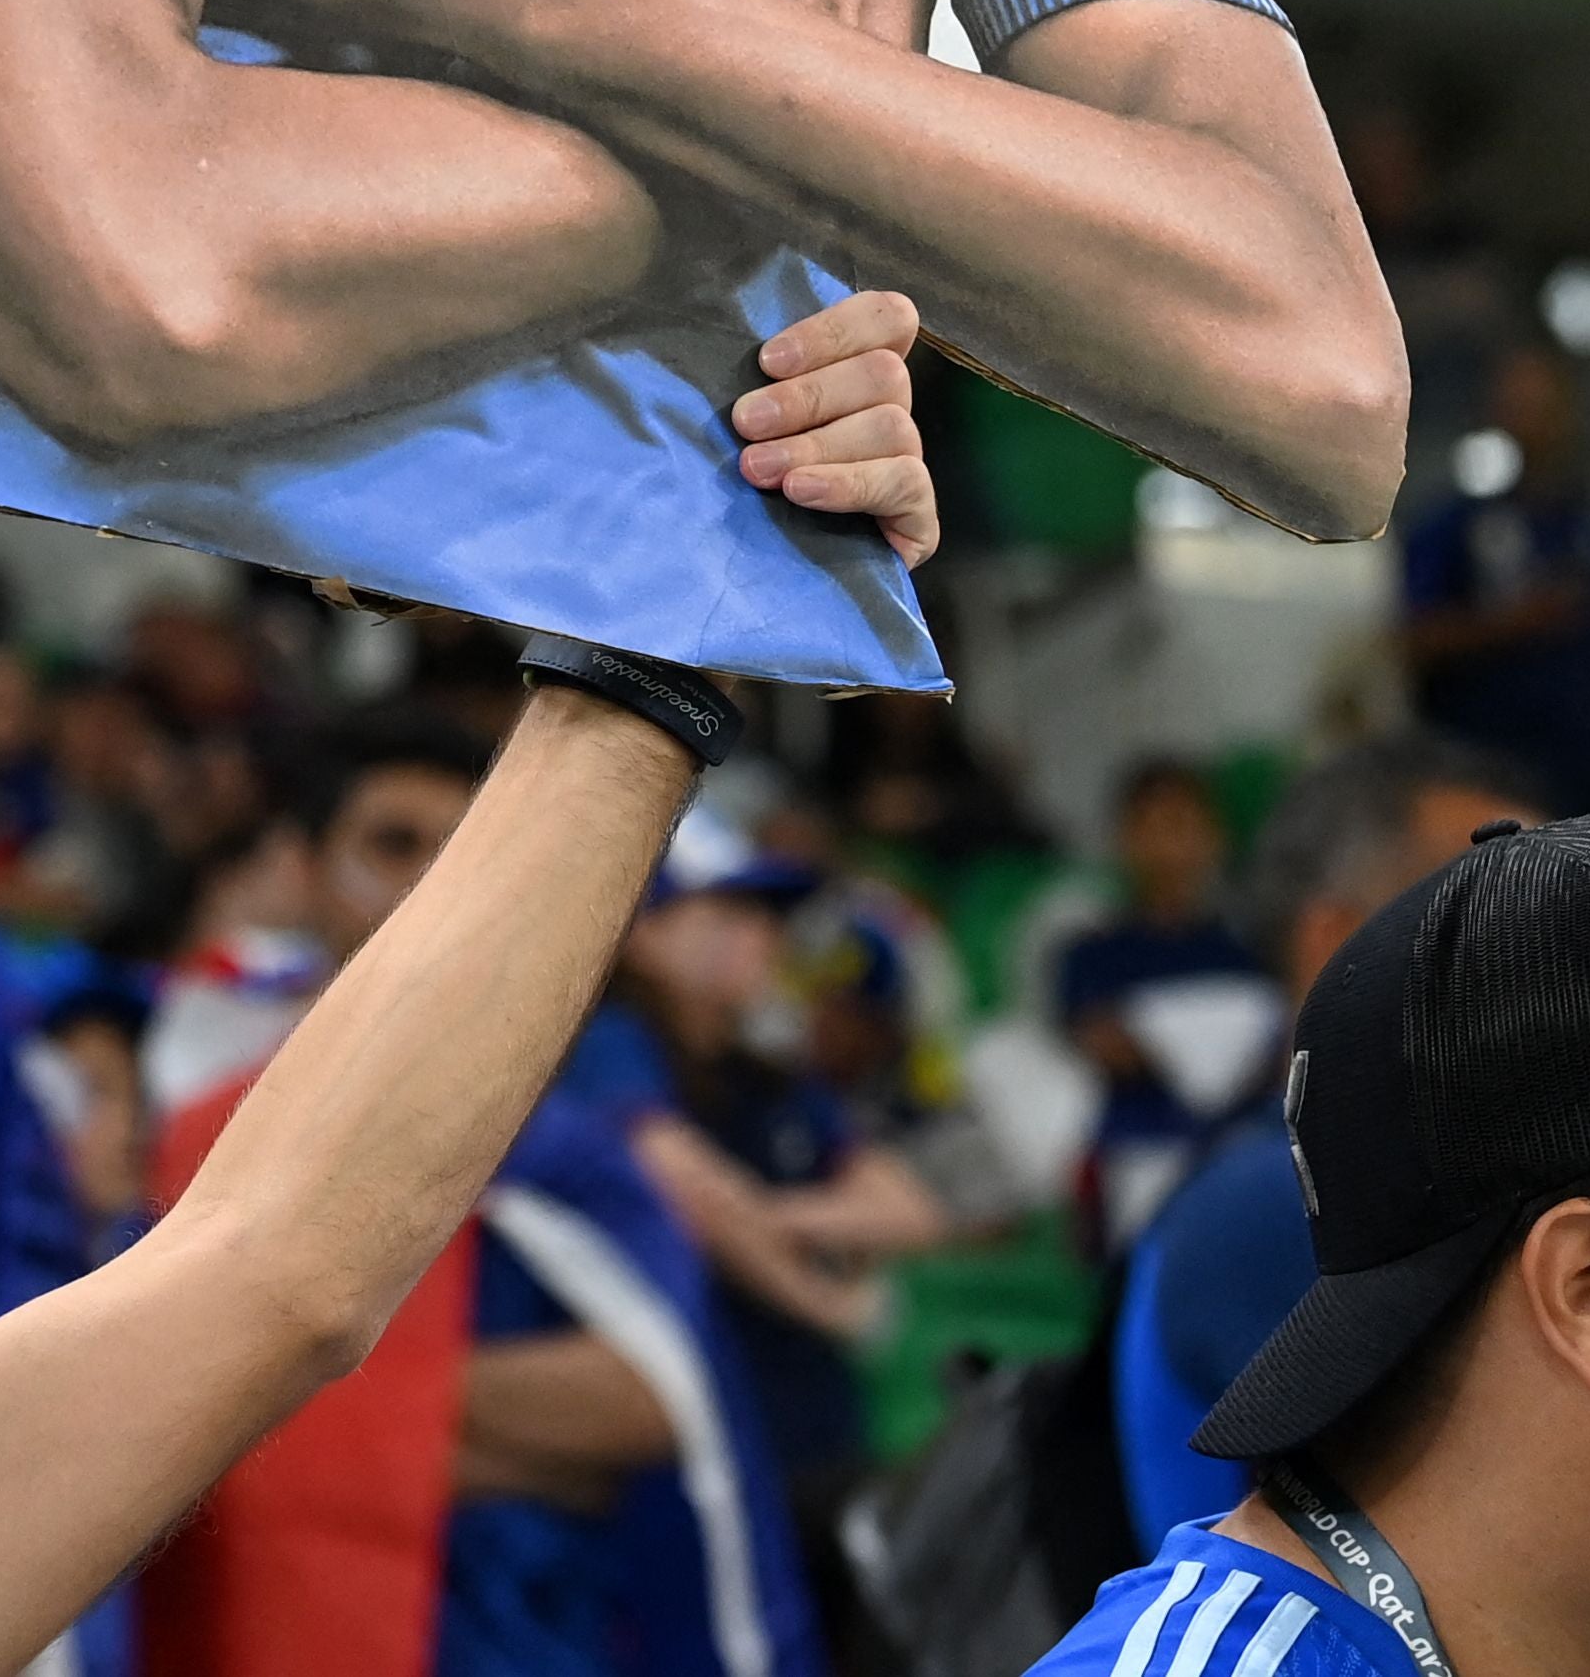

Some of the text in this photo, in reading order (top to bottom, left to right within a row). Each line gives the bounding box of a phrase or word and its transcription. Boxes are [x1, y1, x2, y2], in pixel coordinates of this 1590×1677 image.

[591, 650, 721, 738] Speedmaster
[1285, 1477, 1338, 1532] WORLD
[1329, 1529, 1371, 1568] CUP
